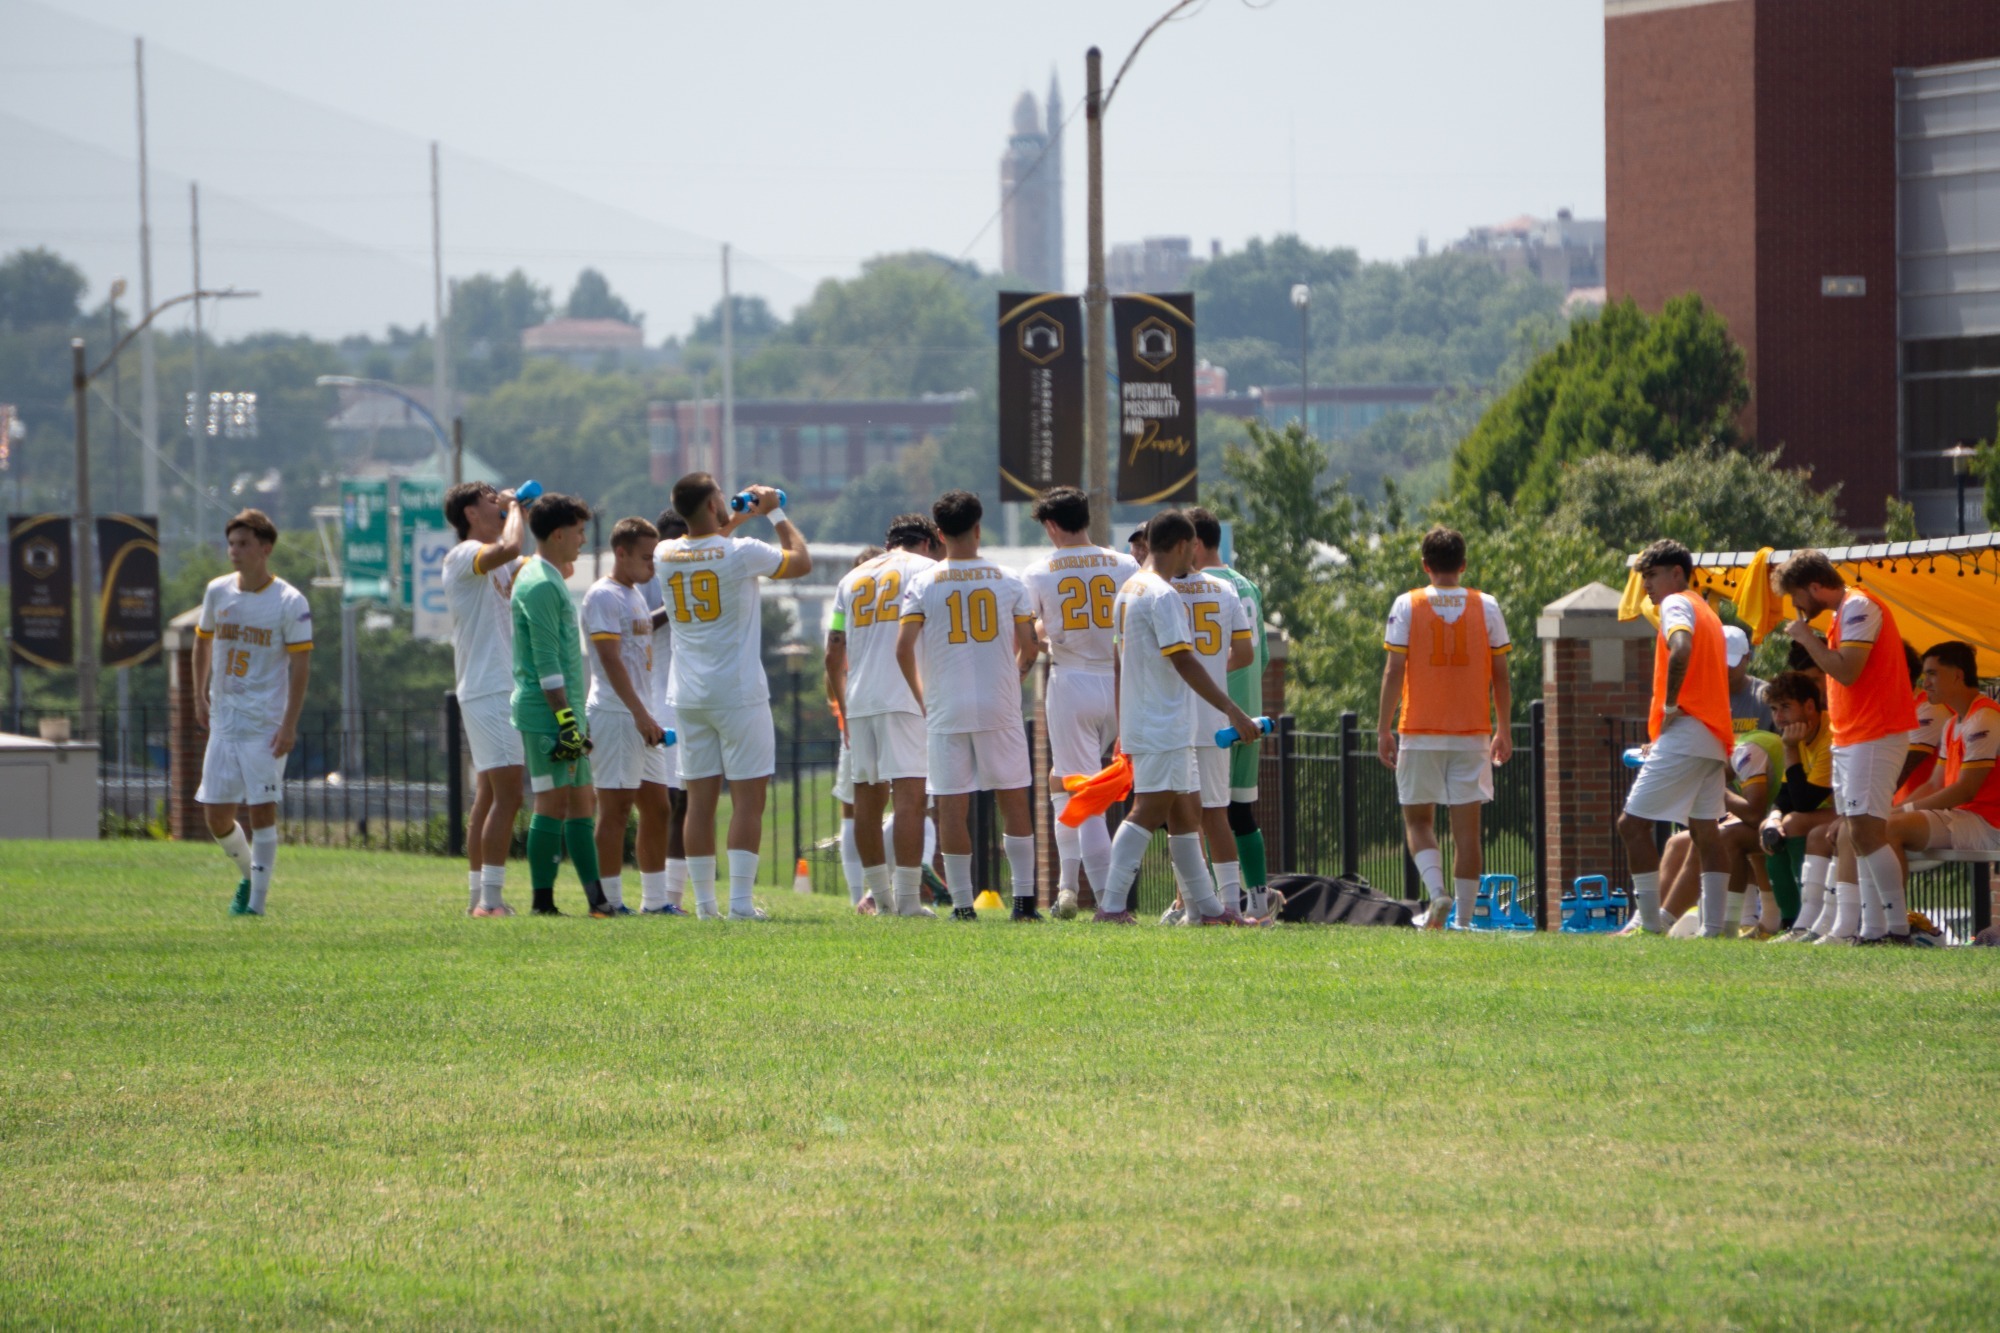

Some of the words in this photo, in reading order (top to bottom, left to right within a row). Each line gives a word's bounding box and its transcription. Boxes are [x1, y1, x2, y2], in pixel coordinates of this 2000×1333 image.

[1124, 382, 1177, 400] POTENTIAL,
[1124, 399, 1180, 418] POSSIBILITY
[1124, 417, 1145, 435] AND
[421, 545, 449, 613] SLU
[934, 566, 1003, 585] HORNETS
[1049, 554, 1119, 573] HORNETS
[668, 569, 721, 623] 19
[851, 569, 901, 629] 22
[1058, 574, 1116, 631] 26
[1171, 580, 1222, 595] RNETS
[946, 587, 999, 645] 10
[1183, 601, 1222, 656] 5
[1430, 615, 1470, 666] 11
[225, 647, 251, 678] 15
